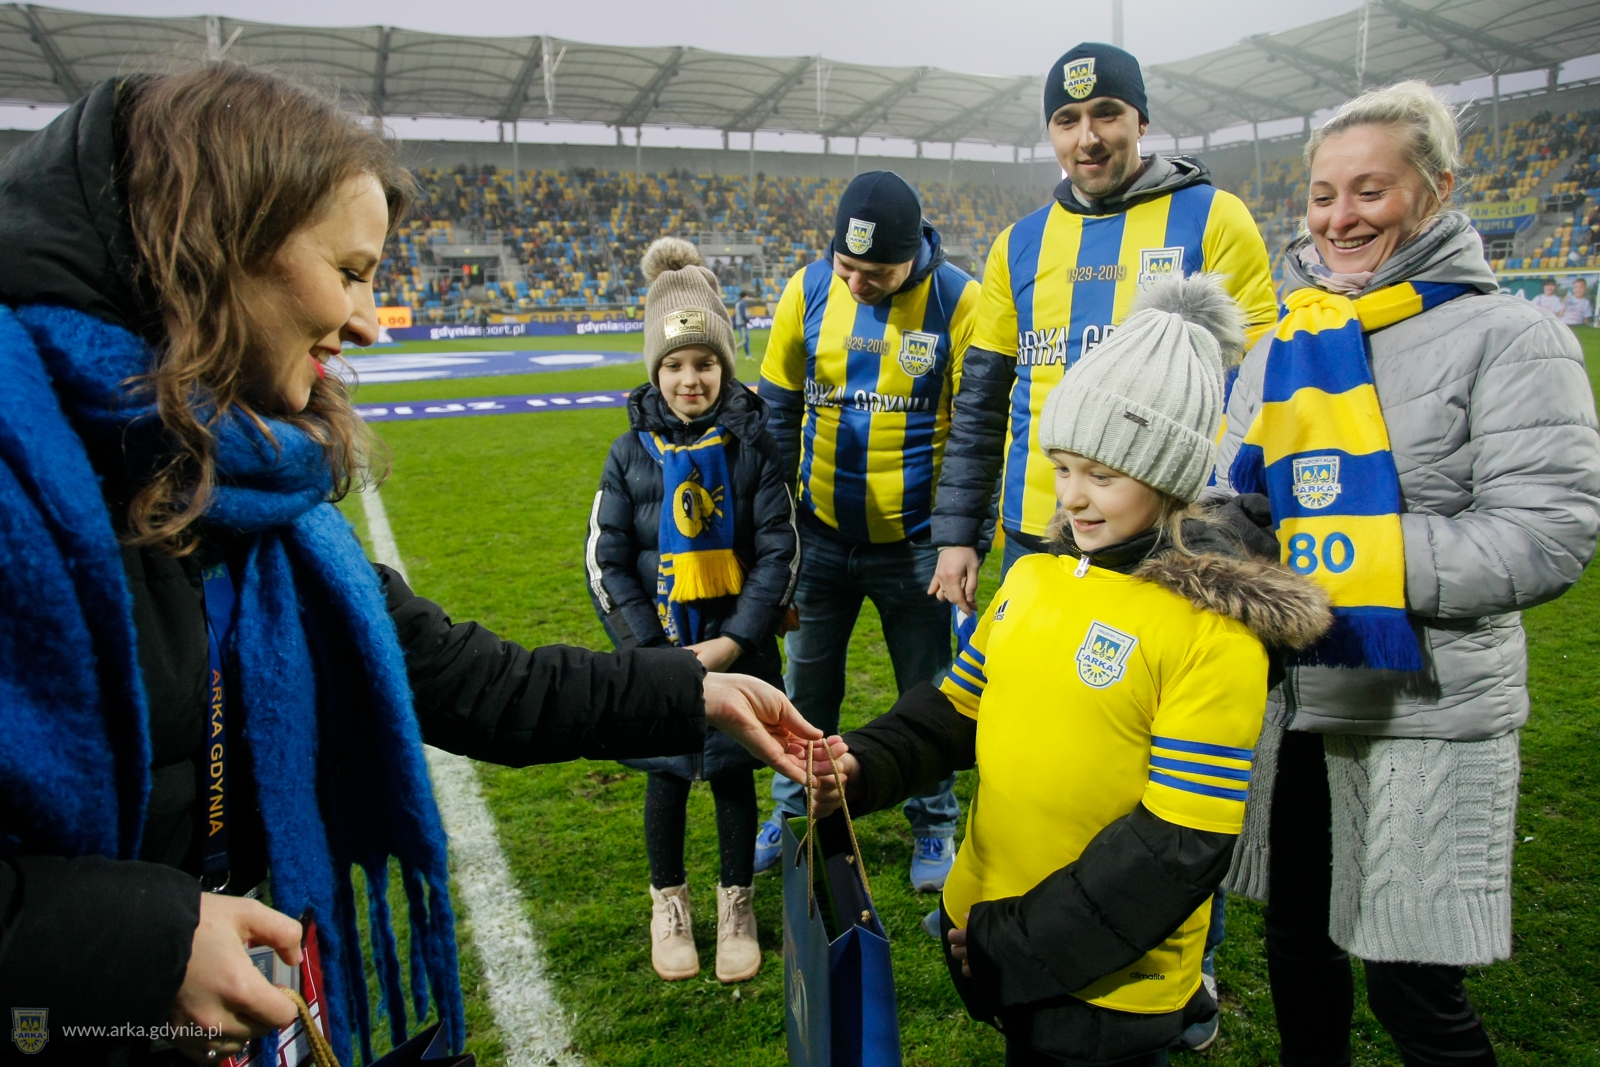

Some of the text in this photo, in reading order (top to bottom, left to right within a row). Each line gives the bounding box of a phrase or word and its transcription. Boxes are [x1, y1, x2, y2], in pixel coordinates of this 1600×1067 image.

[1068, 76, 1092, 87] ARKA
[1067, 265, 1127, 283] 1929-2019
[576, 320, 645, 335] gdyniaspor
[844, 336, 890, 356] 1929-2019
[904, 355, 929, 364] ARKA
[1300, 485, 1334, 493] ARKA
[1288, 531, 1355, 575] 80
[1083, 654, 1114, 673] ARKA
[209, 668, 224, 837] ARKA GDYNIA
[1130, 972, 1165, 980] climalite
